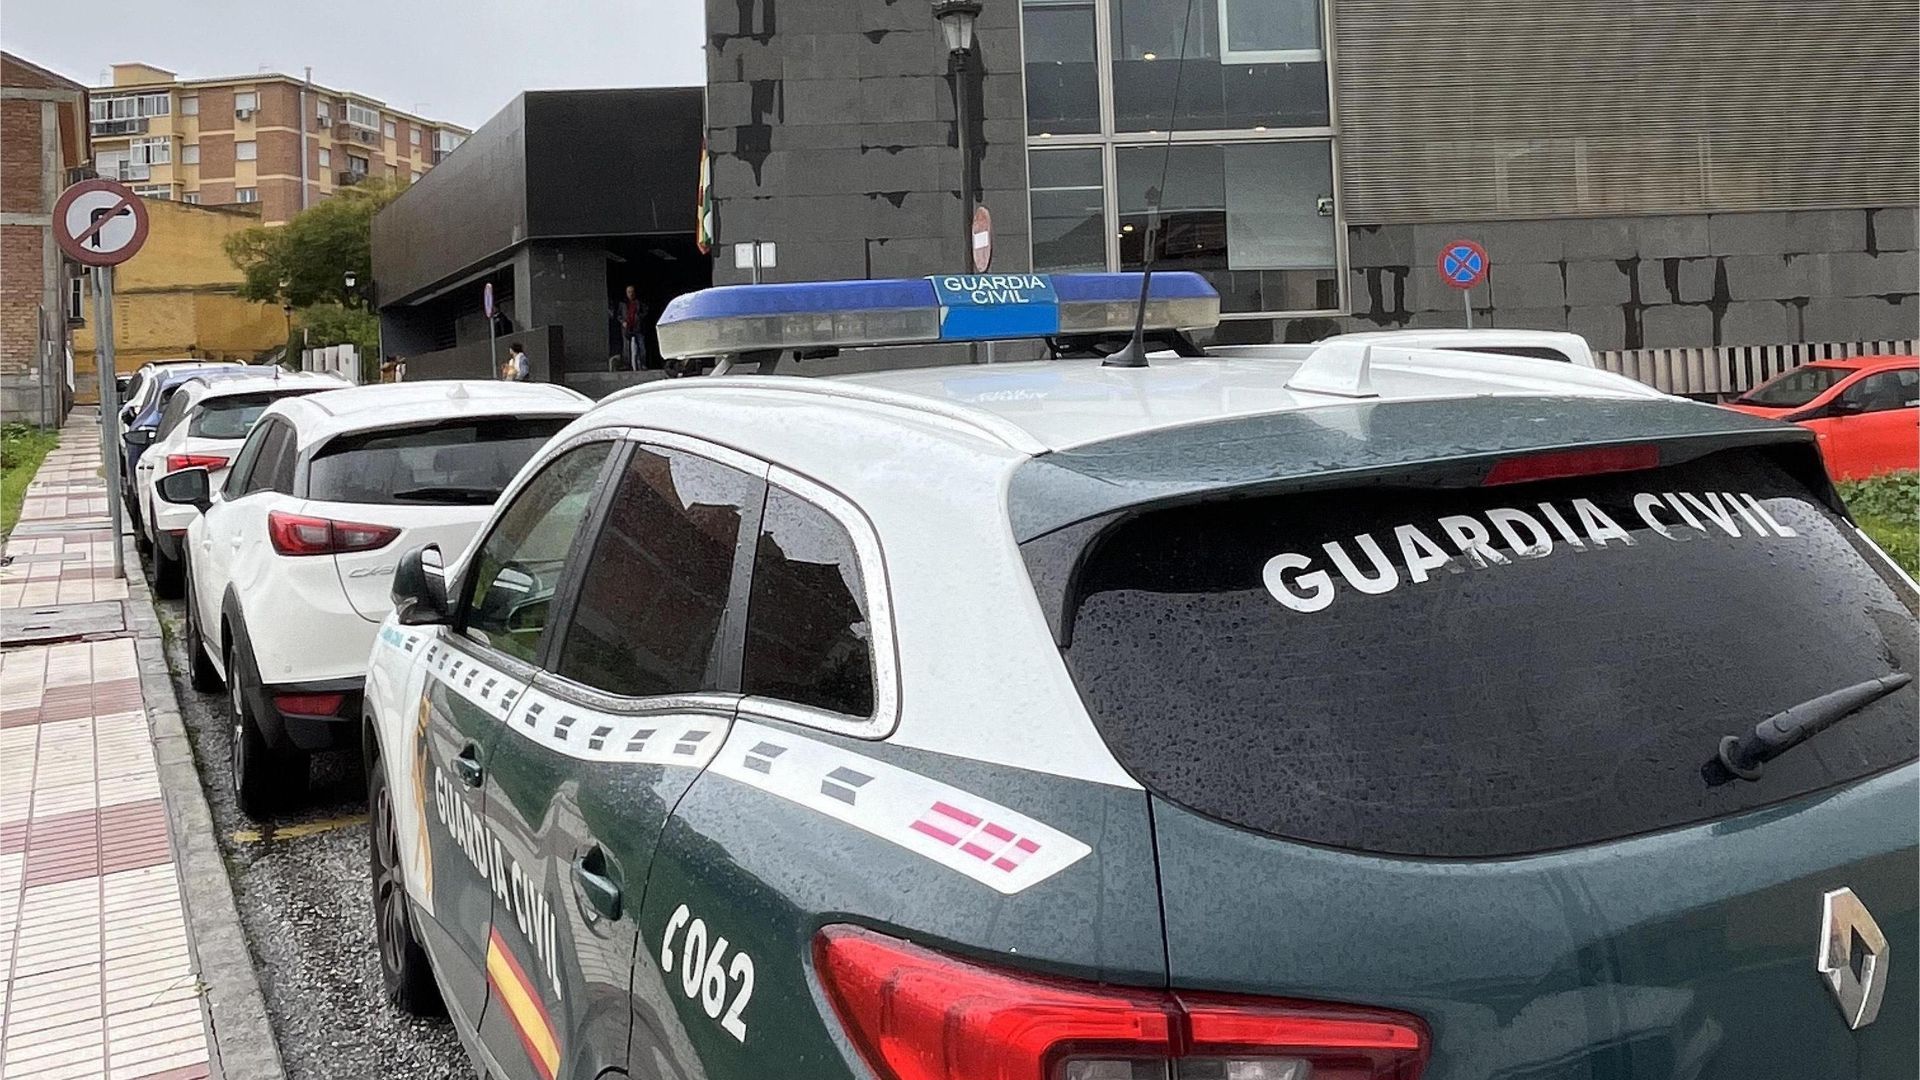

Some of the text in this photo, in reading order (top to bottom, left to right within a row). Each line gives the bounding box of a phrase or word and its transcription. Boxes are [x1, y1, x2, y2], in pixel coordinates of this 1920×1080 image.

[944, 276, 1046, 291] GUARDIA
[971, 290, 1030, 304] CIVIL
[1262, 492, 1800, 613] GUARDIA CIVIL
[435, 766, 562, 1001] GUARDIA CIVIL
[682, 918, 755, 1043] 062
